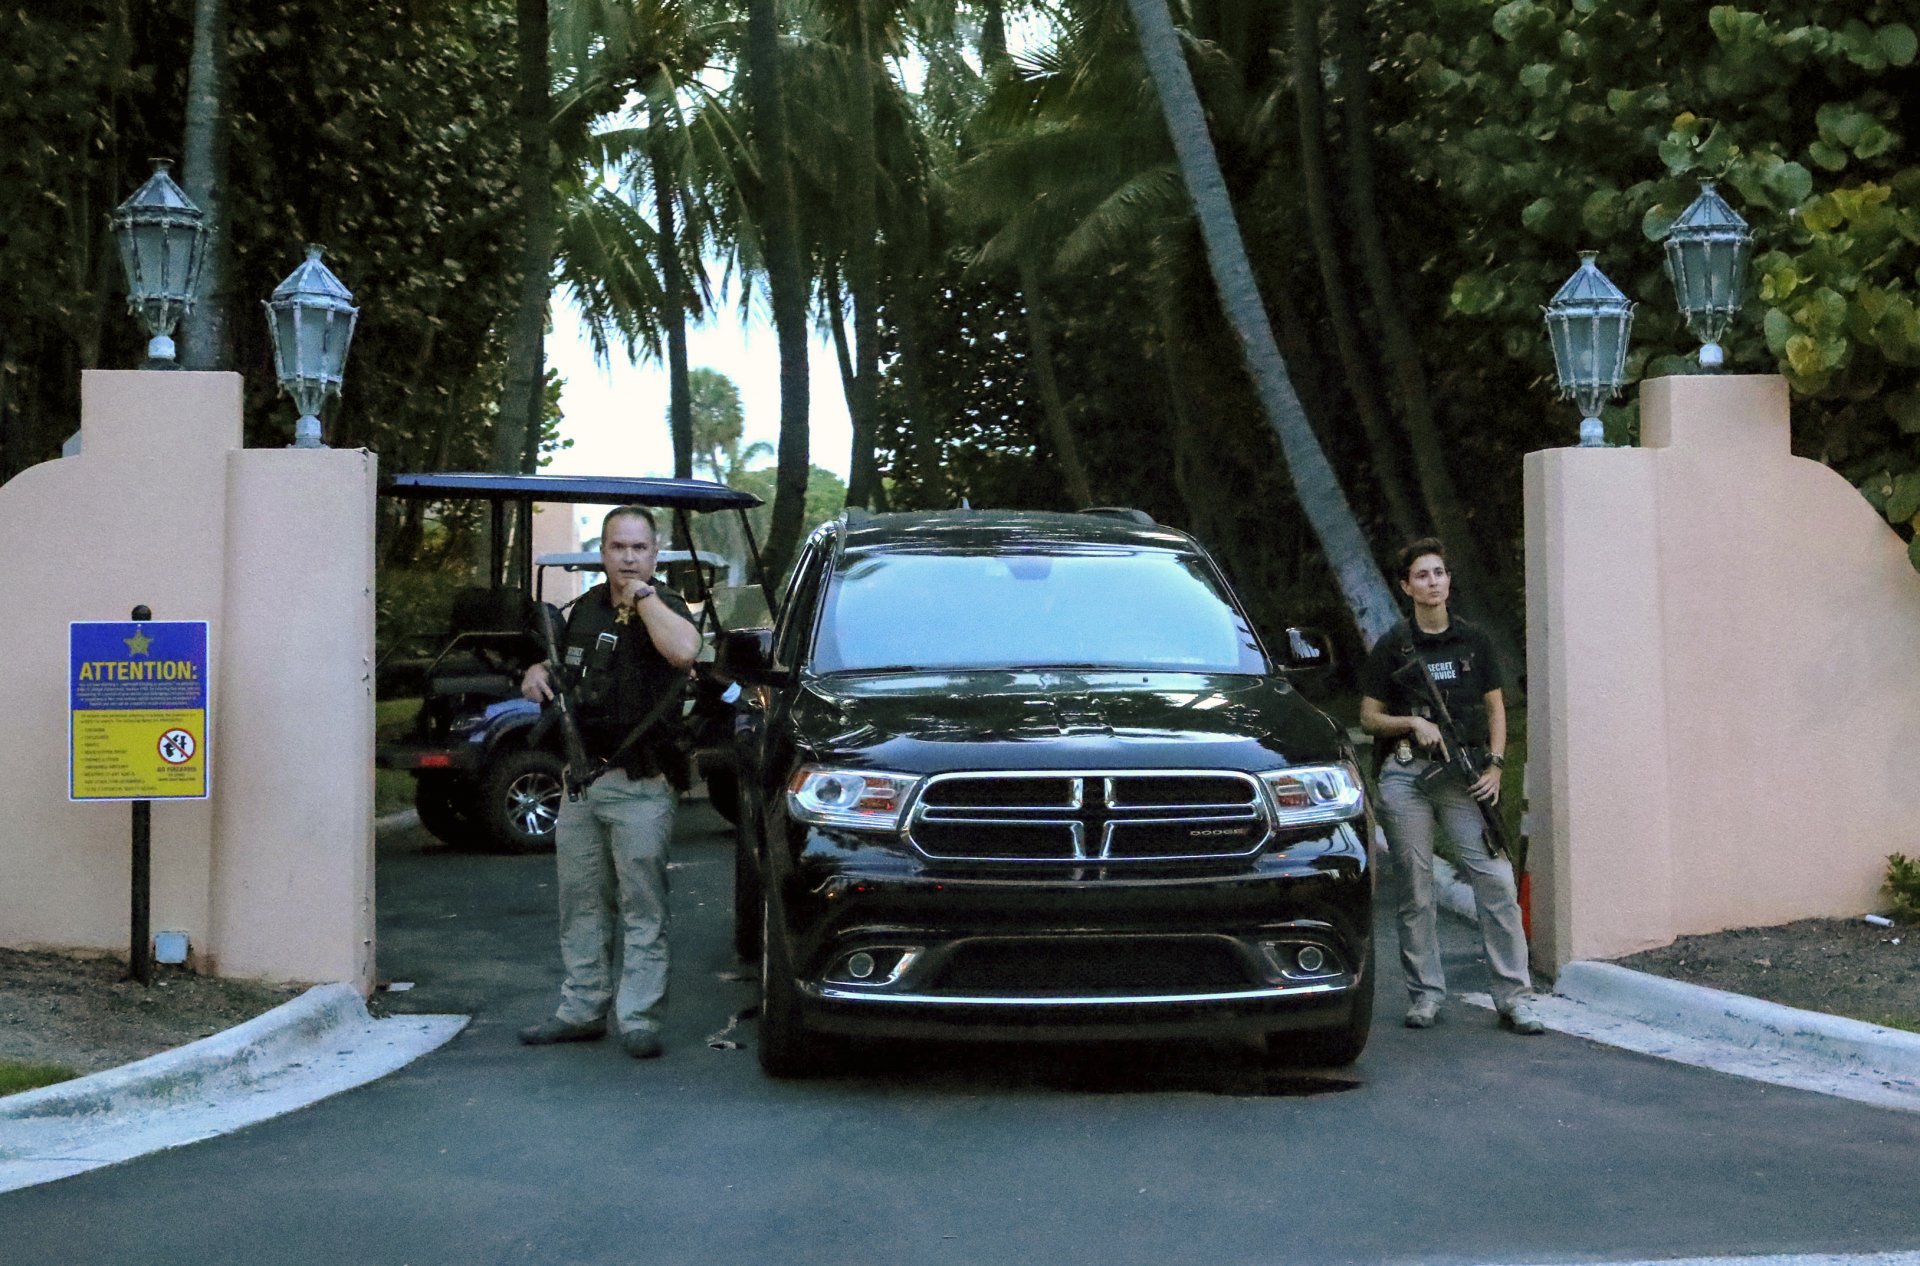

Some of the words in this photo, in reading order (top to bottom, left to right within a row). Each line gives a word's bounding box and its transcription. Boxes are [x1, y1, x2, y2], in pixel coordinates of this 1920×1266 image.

[80, 661, 197, 680] ATTENTION:
[1427, 661, 1452, 672] SECRET
[1190, 828, 1248, 836] DODGE
